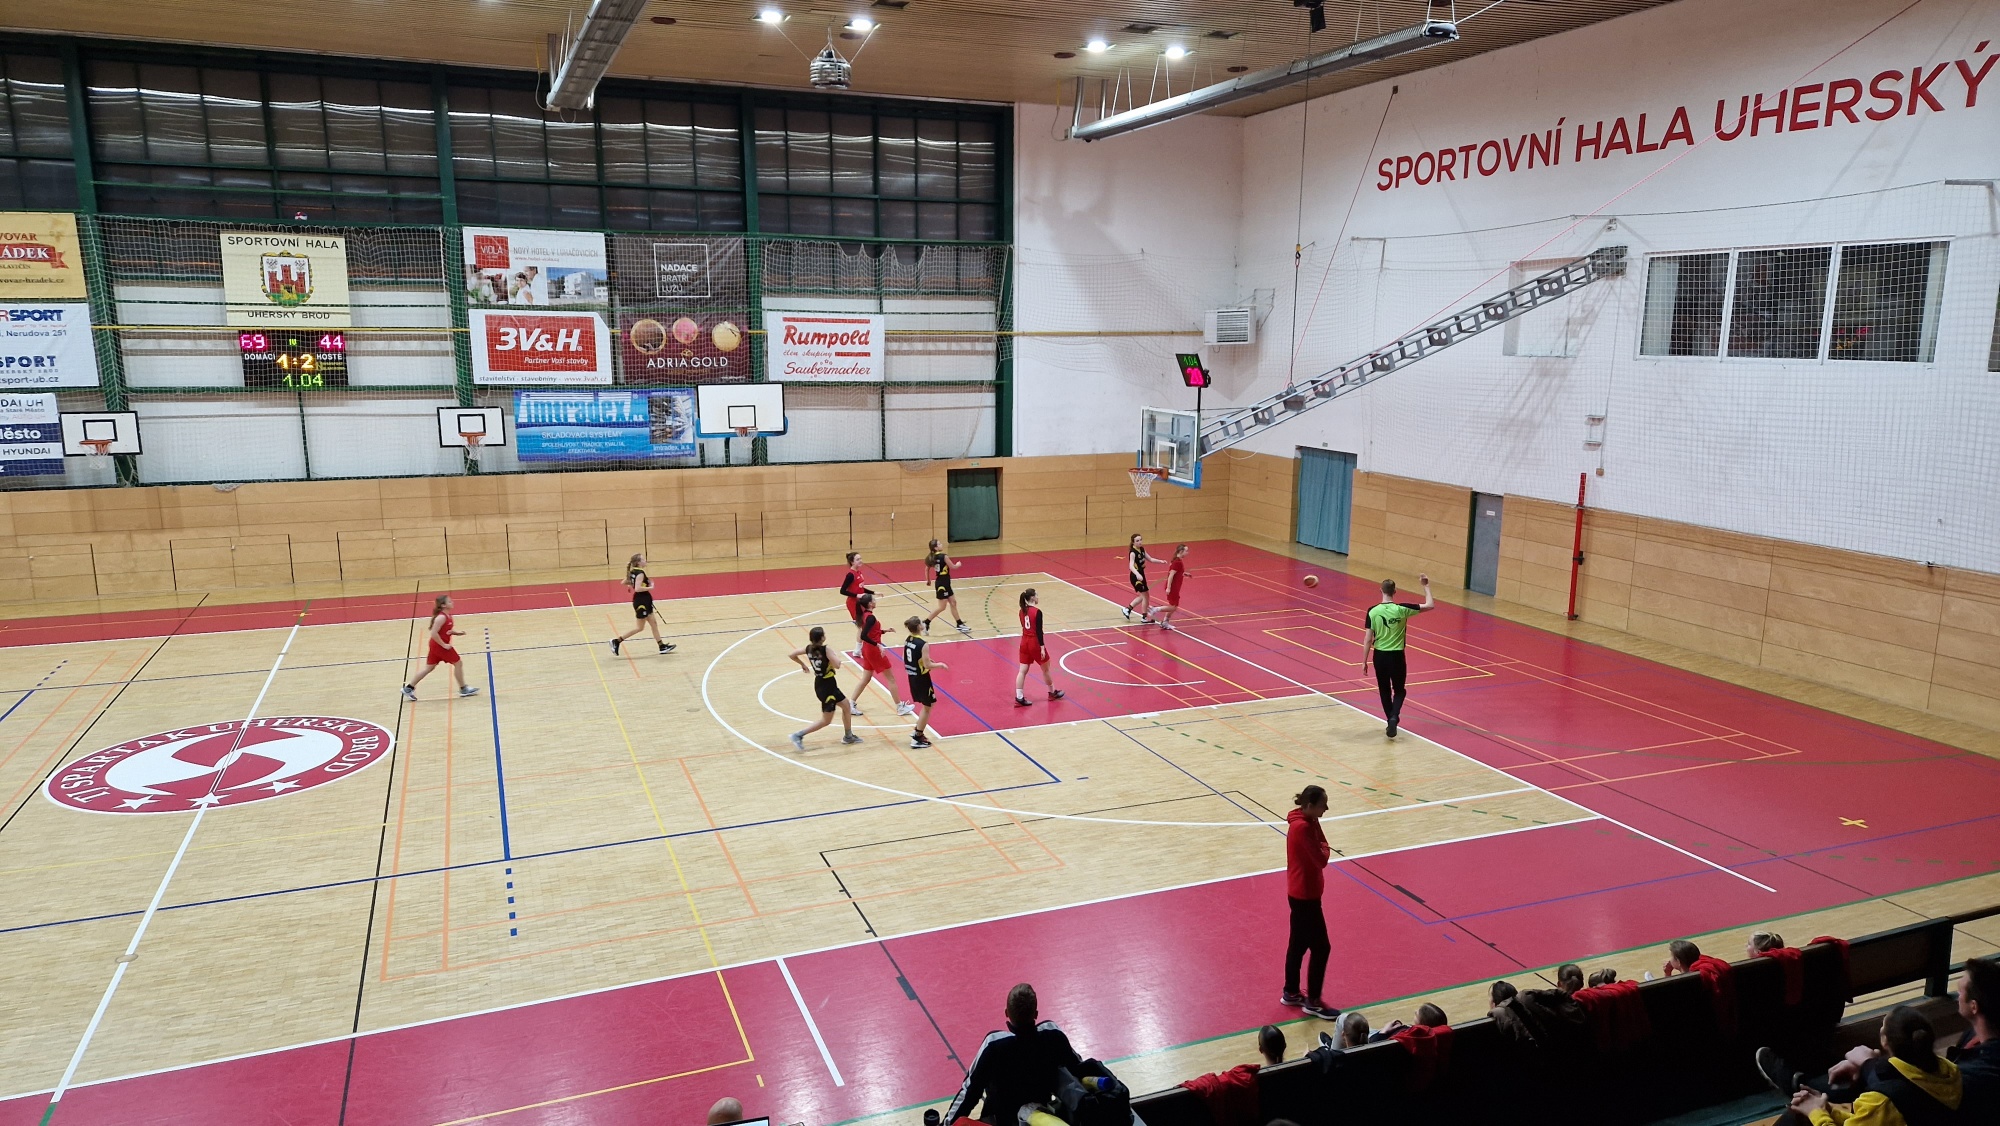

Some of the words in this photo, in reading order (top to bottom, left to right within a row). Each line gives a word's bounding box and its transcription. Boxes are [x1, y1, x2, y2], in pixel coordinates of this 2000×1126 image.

[1377, 117, 1566, 192] SPORTOVNÍ
[1575, 106, 1695, 163] HALA
[1715, 40, 2000, 142] UHERSKÝ
[227, 236, 300, 247] SPORTOVNÍ
[305, 239, 339, 249] HALA
[0, 245, 50, 259] ÁDEK
[531, 247, 550, 256] HOTEL
[660, 263, 698, 272] NADACE
[301, 311, 330, 319] BROD
[52, 329, 67, 337] 251
[495, 327, 581, 352] 3V&H
[783, 325, 871, 349] Rumpold
[240, 334, 266, 349] 69
[320, 334, 343, 349] 44
[783, 349, 799, 357] člen
[802, 349, 833, 358] skupiny
[524, 357, 550, 365] Partner
[566, 357, 588, 366] stavby
[784, 361, 871, 375] Saubermacher
[0, 376, 59, 385] sport-ub.cz
[26, 398, 44, 407] UH
[2, 447, 51, 456] HYUNDAI
[1024, 615, 1031, 630] 8
[906, 648, 913, 663] 9
[60, 730, 196, 790] SPARTAK
[206, 717, 379, 736] UHERSKÝ
[323, 734, 379, 773] BROD
